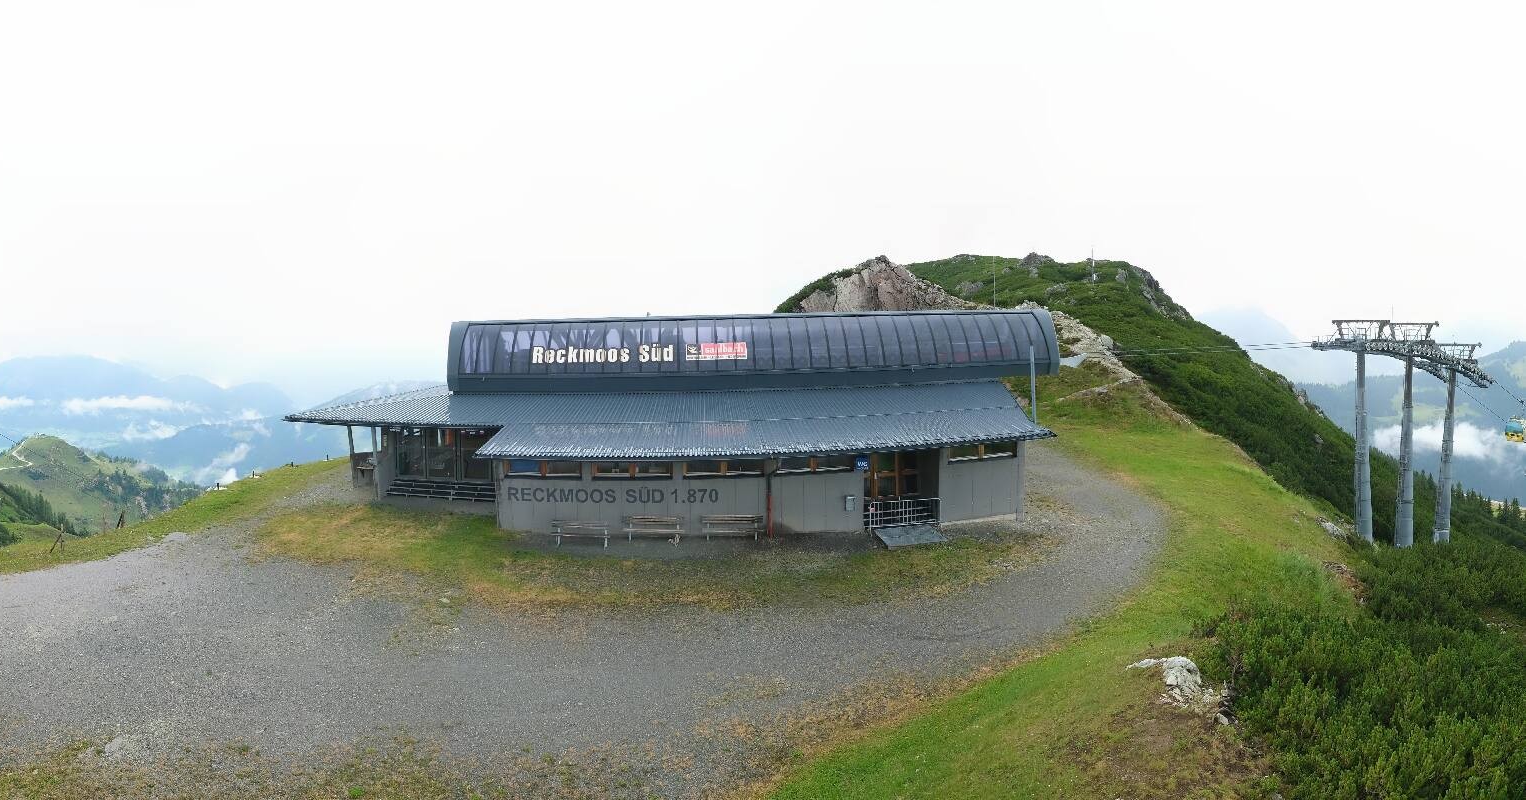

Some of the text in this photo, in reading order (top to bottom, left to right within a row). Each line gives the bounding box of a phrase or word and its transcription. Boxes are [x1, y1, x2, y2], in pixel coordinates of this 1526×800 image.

[532, 343, 674, 364] Reckmoos Süd
[507, 486, 719, 504] RECKMOOS SÜD 1.870
